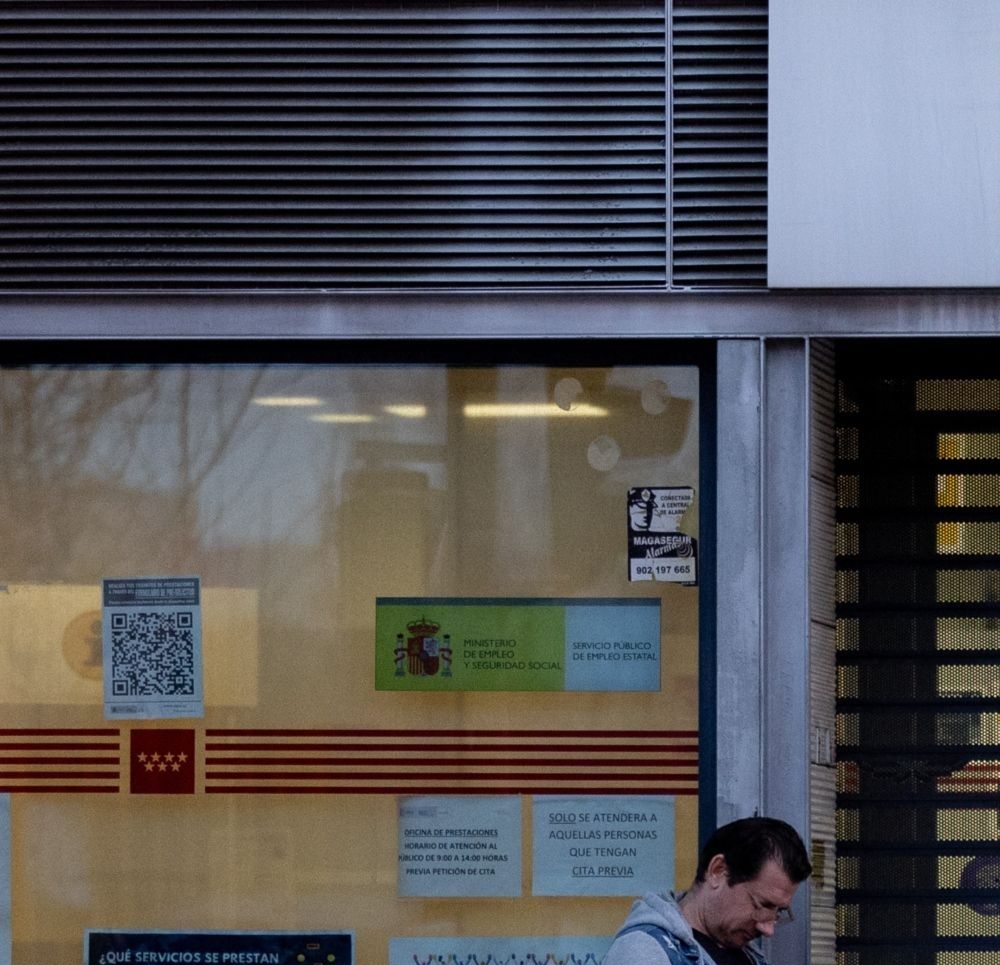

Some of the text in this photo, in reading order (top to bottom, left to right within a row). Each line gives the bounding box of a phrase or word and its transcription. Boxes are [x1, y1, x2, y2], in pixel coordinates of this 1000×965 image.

[636, 565, 691, 575] 902 197 665
[463, 639, 517, 648] MINISTERIO
[572, 639, 652, 650] SERVICIO PÚBLICO
[463, 650, 515, 659] DE EMPLEO
[572, 652, 658, 661] DE EMPLEO ESTATAL
[463, 661, 562, 671] Y SEGURIDAD SOCIAL
[548, 813, 658, 824] SOLO SE ATENDERA A
[404, 828, 498, 837] OFICINA DE PRESTACIONES
[548, 830, 658, 840] AQUELLAS PERSONAS
[404, 841, 498, 850] HORARIO DE ATENCIÓN AL
[425, 854, 435, 862] DE
[436, 854, 452, 862] 9:00
[453, 854, 460, 862] A
[461, 854, 480, 862] 14:00
[482, 854, 508, 862] HORAS
[569, 847, 637, 859] QUE TENGAN
[406, 866, 496, 876] PREVIA PETICIÓN DE CITA
[572, 866, 634, 877] CITA PREVIA
[99, 949, 280, 965] ¿QUÉ SERVICIOS SE PRESTAN
